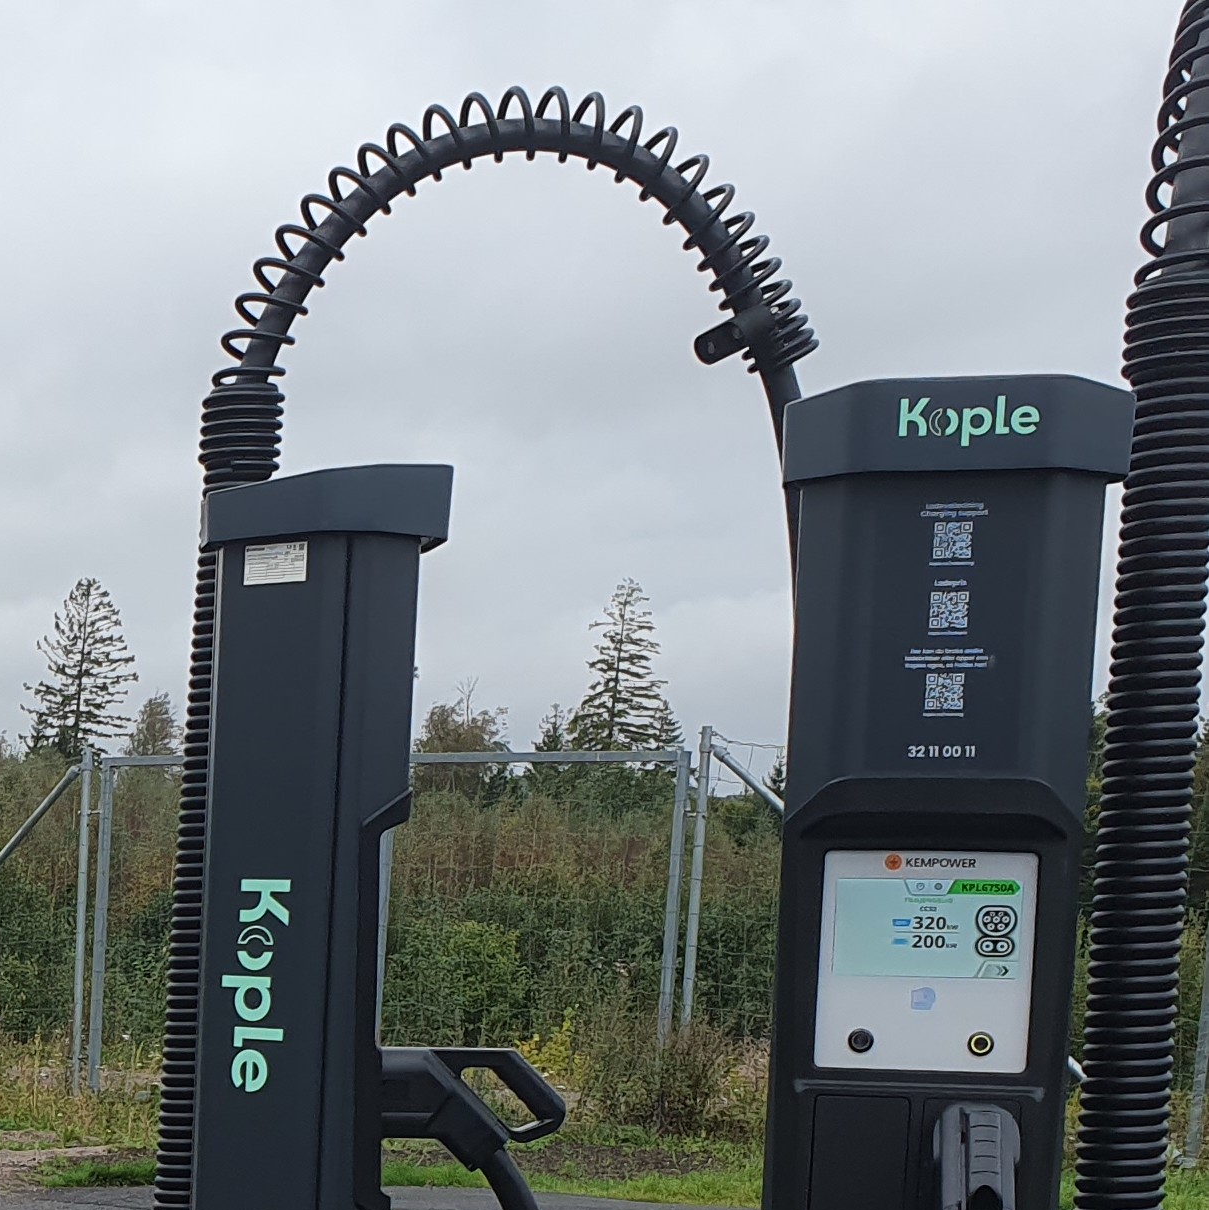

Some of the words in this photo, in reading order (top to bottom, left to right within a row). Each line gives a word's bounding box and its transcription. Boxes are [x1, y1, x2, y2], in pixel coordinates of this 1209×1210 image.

[898, 395, 1040, 447] Kople
[907, 745, 926, 758] 32
[928, 745, 940, 758] 11
[942, 745, 962, 758] 00
[964, 745, 976, 758] 11
[905, 857, 977, 869] KEMPOWER
[912, 915, 947, 931] 320
[911, 934, 946, 949] 200
[221, 878, 292, 1093] Kople
